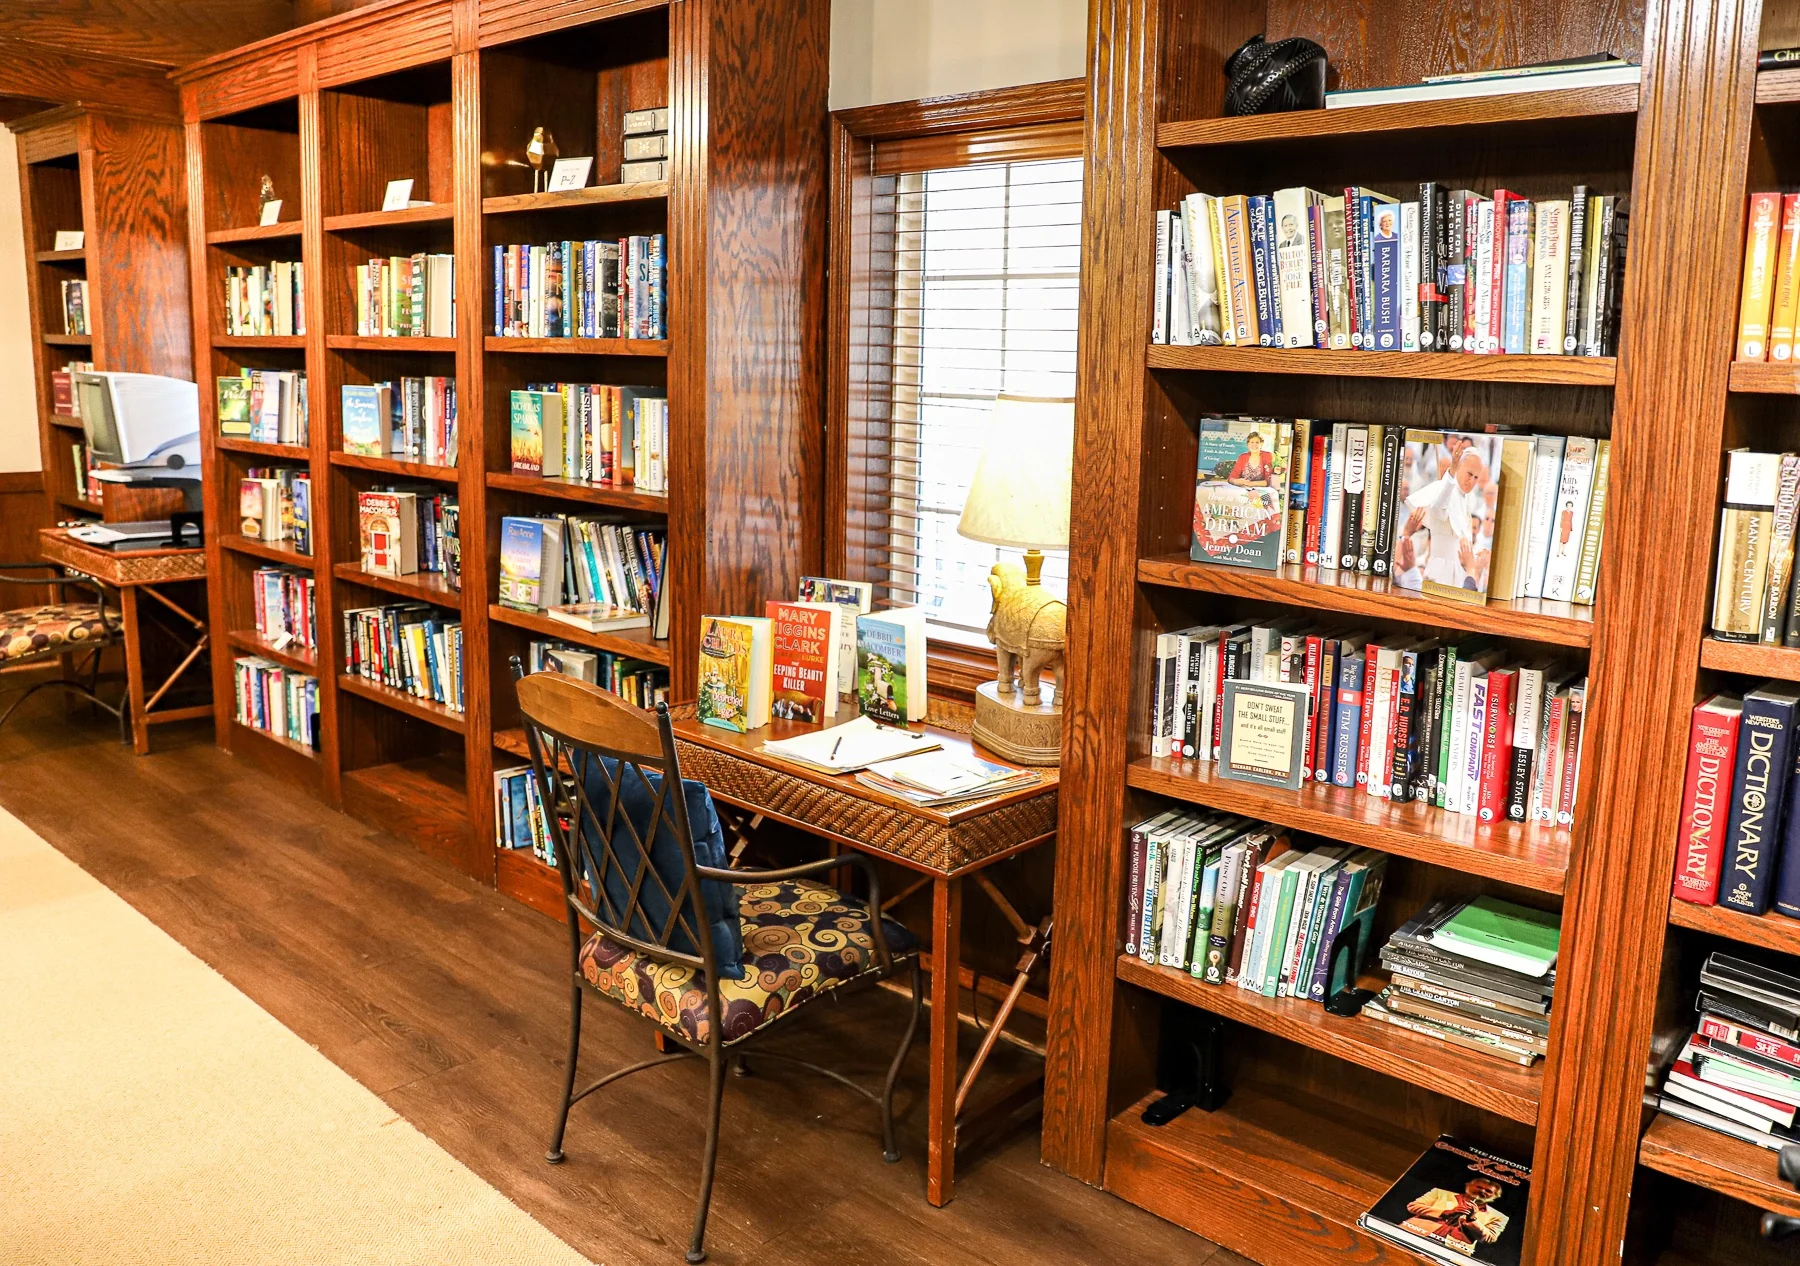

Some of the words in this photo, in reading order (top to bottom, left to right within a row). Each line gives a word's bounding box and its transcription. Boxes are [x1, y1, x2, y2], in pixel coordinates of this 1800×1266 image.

[1573, 194, 1585, 210] DALE
[1157, 221, 1165, 237] TIM
[1256, 207, 1265, 241] GRACIE
[1571, 212, 1584, 250] EARNHARDT
[1157, 238, 1166, 265] ALLEN
[1255, 248, 1264, 288] GEORGE
[1285, 273, 1304, 282] JOKE
[1259, 288, 1267, 320] BURNS
[1294, 422, 1305, 444] JOHN
[513, 461, 540, 473] DREAMLAND
[1294, 446, 1303, 479] GRISHAM
[1351, 439, 1364, 484] FRIDA
[1384, 442, 1393, 486] SEABISCUIT
[1203, 504, 1272, 521] AMERICAN
[1589, 489, 1605, 527] CHARLES
[1776, 467, 1797, 539] CATHOLICISM
[1205, 517, 1266, 537] DREAM
[1292, 521, 1300, 538] GRAY
[1748, 517, 1759, 544] MAN
[1204, 543, 1232, 557] Jenny
[1236, 544, 1262, 557] Doan
[1580, 529, 1599, 589] KRAUTHAMME
[1773, 553, 1785, 585] ROBERT
[1739, 560, 1755, 616] CENTURY
[1768, 587, 1782, 620] BARRON
[778, 608, 818, 624] MARY
[707, 624, 744, 641] LAURA
[866, 629, 894, 643] DEBBIE
[774, 636, 820, 655] CLARK
[858, 642, 902, 658] MACOMBER
[1308, 644, 1316, 666] KILLING
[801, 655, 824, 664] BURKE
[1368, 660, 1376, 668] If
[774, 663, 798, 678] EEPING
[799, 666, 824, 682] BEAUTY
[1458, 666, 1466, 691] SARAH
[783, 678, 805, 691] KILLER
[1366, 676, 1374, 695] Can't
[713, 689, 744, 708] Scorched
[1364, 698, 1373, 717] Have
[1401, 698, 1410, 713] E.R.
[1523, 672, 1534, 723] REPORTING
[865, 704, 882, 717] Love
[879, 708, 901, 721] Letters
[1238, 710, 1249, 720] THE
[1250, 712, 1268, 723] SMALL
[1247, 701, 1264, 713] DON'T
[1265, 703, 1283, 715] SWEAT
[1472, 684, 1485, 733] FAST
[1341, 709, 1350, 730] TIM
[1363, 720, 1371, 734] You
[1397, 716, 1408, 748] NURSES
[1549, 721, 1558, 746] Cheryl
[1337, 734, 1348, 772] RUSSER
[1467, 732, 1477, 781] COMPANY
[1546, 748, 1555, 777] Strayed
[1516, 749, 1527, 778] LESLEY
[1514, 781, 1524, 805] STAH
[1734, 730, 1774, 880] DICTIONARY
[1686, 756, 1719, 879] DICTIONARY
[1148, 841, 1156, 861] Welk
[1222, 855, 1231, 880] FIRST
[1145, 888, 1153, 907] THIS
[1220, 881, 1228, 899] OFF
[1238, 886, 1247, 908] humor
[1252, 882, 1260, 904] DOCTOR
[1732, 889, 1752, 898] SIMON
[1316, 904, 1325, 923] WISDOM
[1331, 908, 1339, 919] from
[1142, 914, 1151, 946] BELIEVE
[1311, 931, 1319, 944] GOLF
[1328, 920, 1336, 935] Ames
[1390, 963, 1401, 972] THE
[1469, 1146, 1488, 1158] THE
[1490, 1153, 1528, 1173] HISTORY
[1402, 1220, 1427, 1235] TONY
